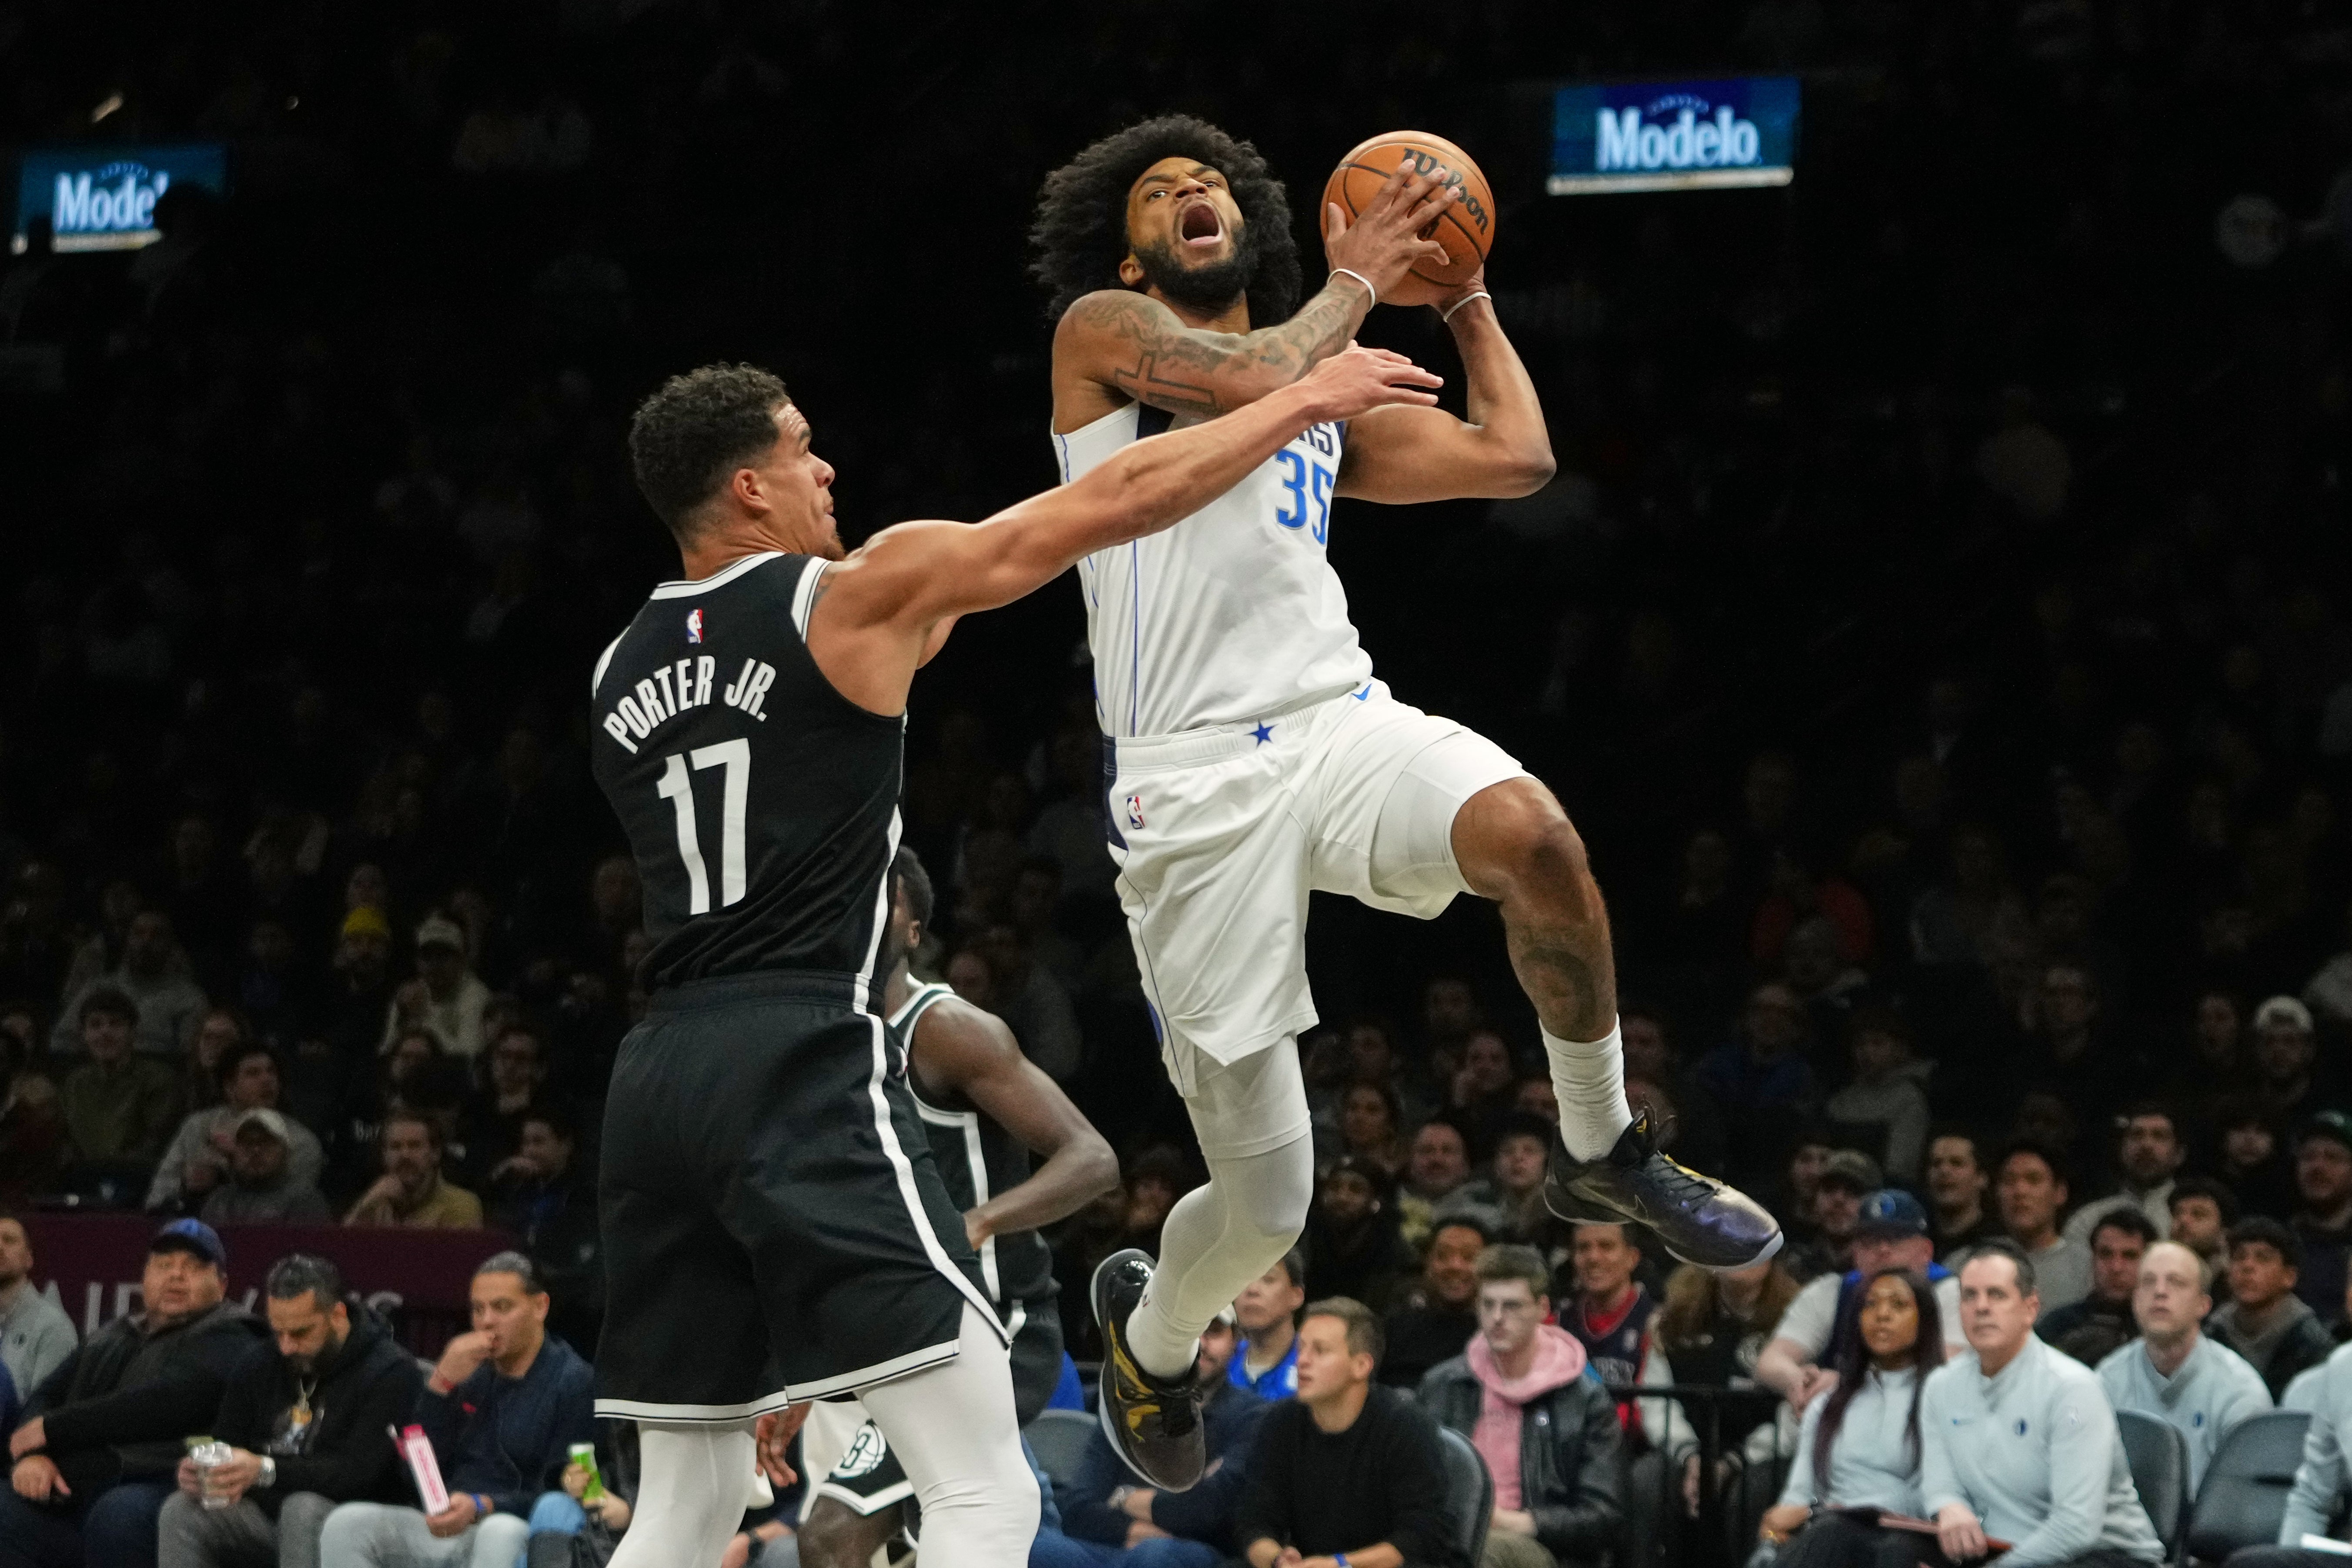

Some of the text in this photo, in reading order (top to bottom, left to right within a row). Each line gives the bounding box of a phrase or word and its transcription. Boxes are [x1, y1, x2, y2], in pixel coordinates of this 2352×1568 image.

[1596, 105, 1759, 171] Modelo
[1402, 147, 1489, 235] Wlson
[1275, 448, 1335, 546] 35
[603, 655, 776, 754] PORTER JR.
[657, 738, 750, 915] 17
